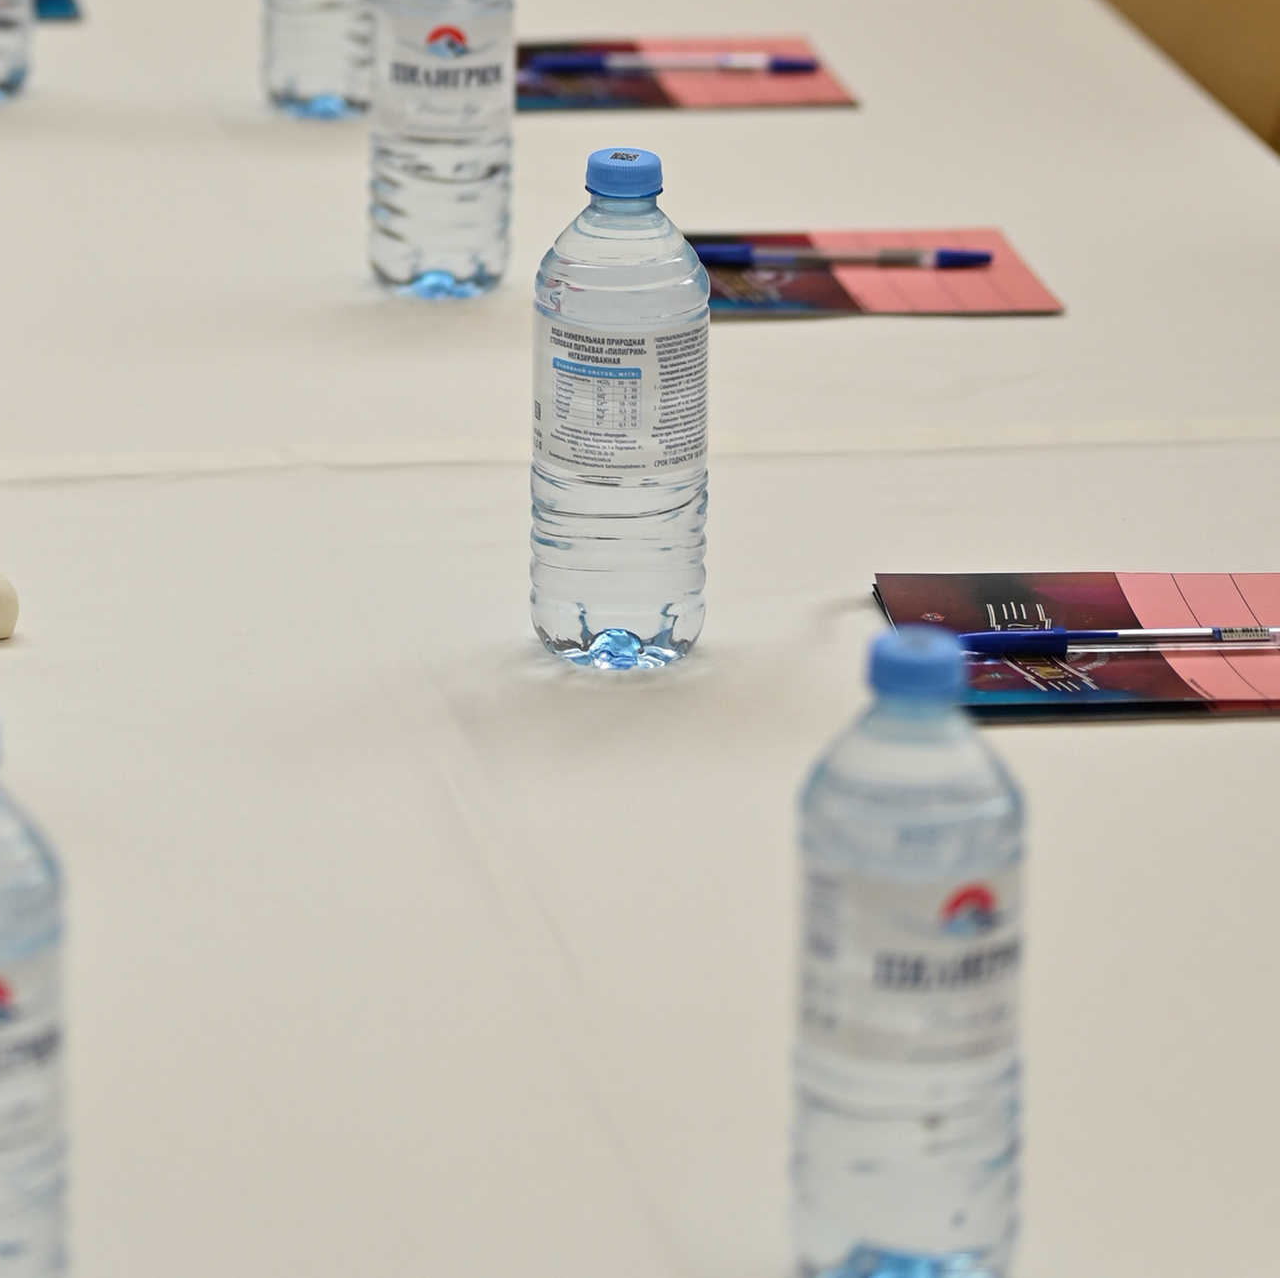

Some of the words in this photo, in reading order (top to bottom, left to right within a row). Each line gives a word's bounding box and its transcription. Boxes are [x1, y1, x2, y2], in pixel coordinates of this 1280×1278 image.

[563, 331, 605, 346] МИНЕРАЛЬНАЯ
[606, 338, 645, 347] ПРИРОДНАЯ
[573, 342, 603, 354] ПИТЬЕВАЯ
[568, 351, 621, 365] НЕГАЗИРОВАННАЯ
